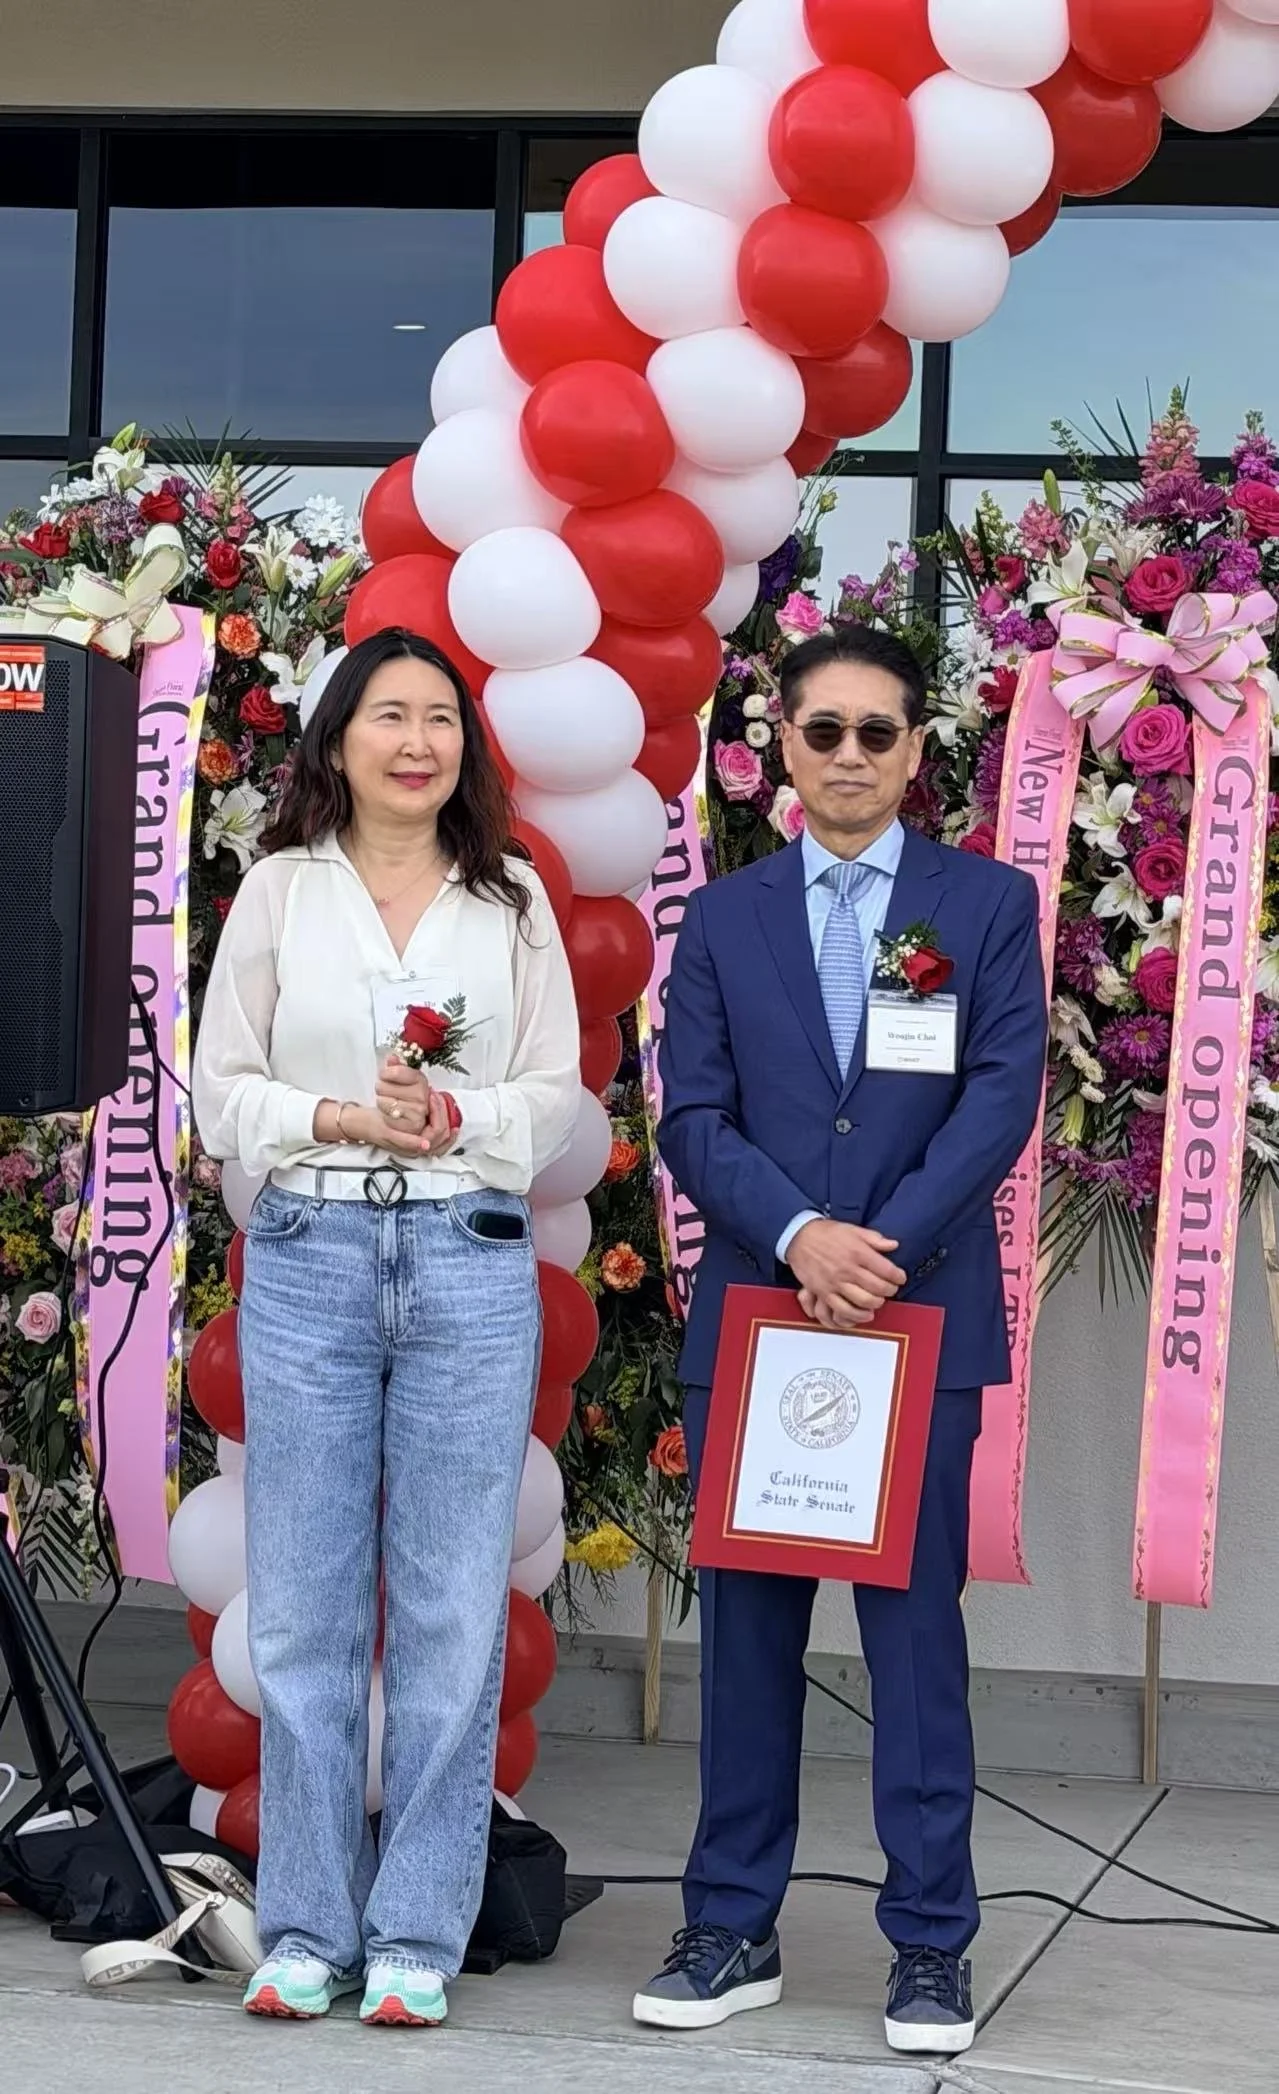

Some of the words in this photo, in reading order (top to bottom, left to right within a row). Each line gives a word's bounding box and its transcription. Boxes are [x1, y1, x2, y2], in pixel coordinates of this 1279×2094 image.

[132, 701, 191, 925] Grand
[1016, 739, 1066, 823] New
[1199, 755, 1257, 1001] Grand
[1162, 1035, 1225, 1374] opening
[758, 1490, 799, 1507] State
[804, 1494, 856, 1514] Senate
[769, 1470, 848, 1493] California
